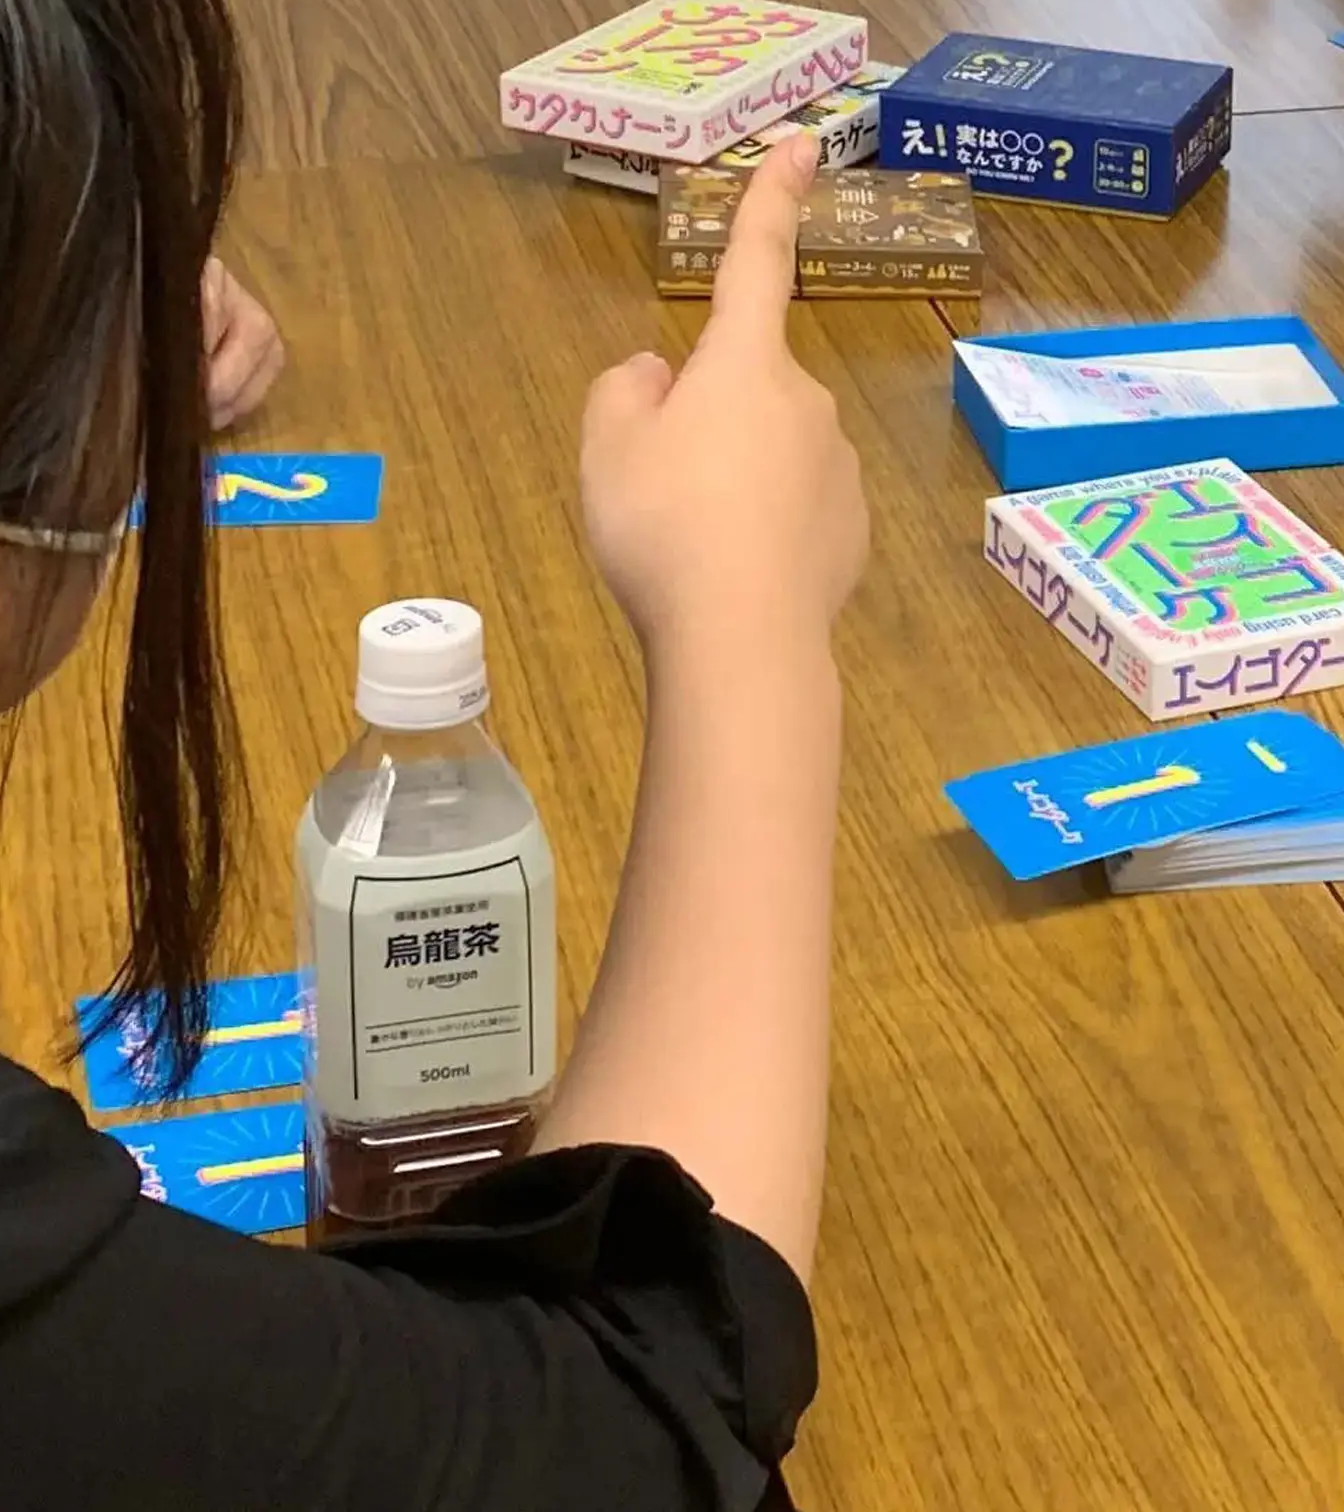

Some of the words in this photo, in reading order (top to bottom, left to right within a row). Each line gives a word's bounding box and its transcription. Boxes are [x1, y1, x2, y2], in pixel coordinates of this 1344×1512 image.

[956, 149, 1044, 174] なんですか
[1140, 472, 1172, 489] you
[986, 512, 1114, 667] エイゴダーケ
[383, 921, 501, 969] 烏龍茶
[427, 969, 479, 989] amazon
[419, 1065, 471, 1084] 500ml
